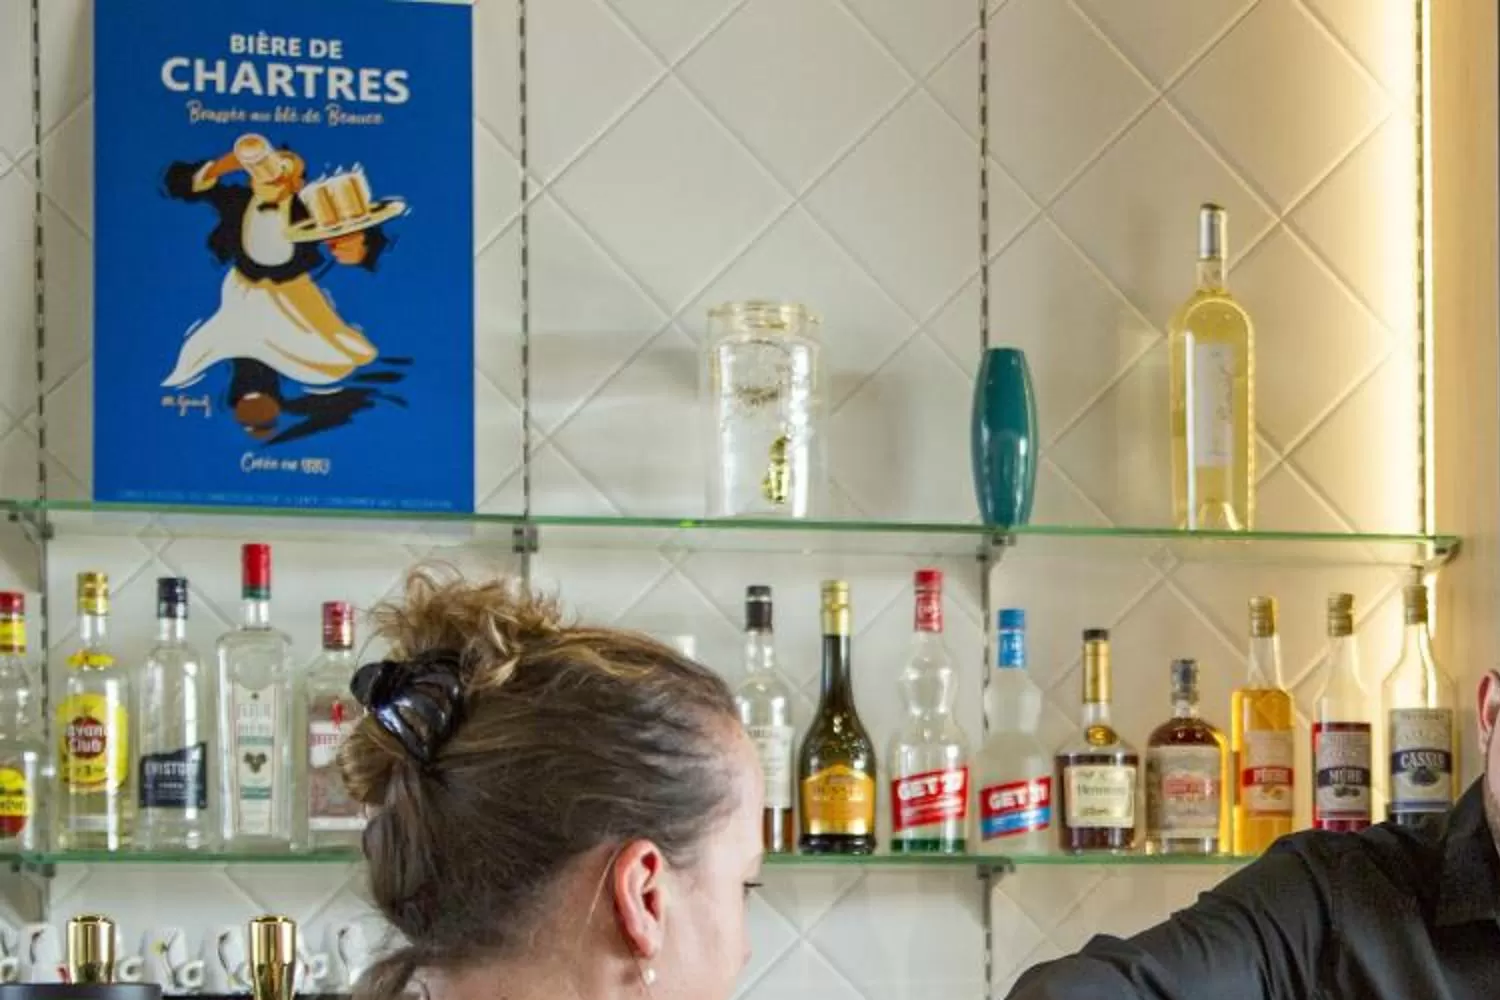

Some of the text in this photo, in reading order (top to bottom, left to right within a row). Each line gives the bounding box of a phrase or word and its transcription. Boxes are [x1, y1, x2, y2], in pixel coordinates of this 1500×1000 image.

[230, 30, 343, 60] BIÈRE DE
[160, 56, 410, 104] CHARTRES
